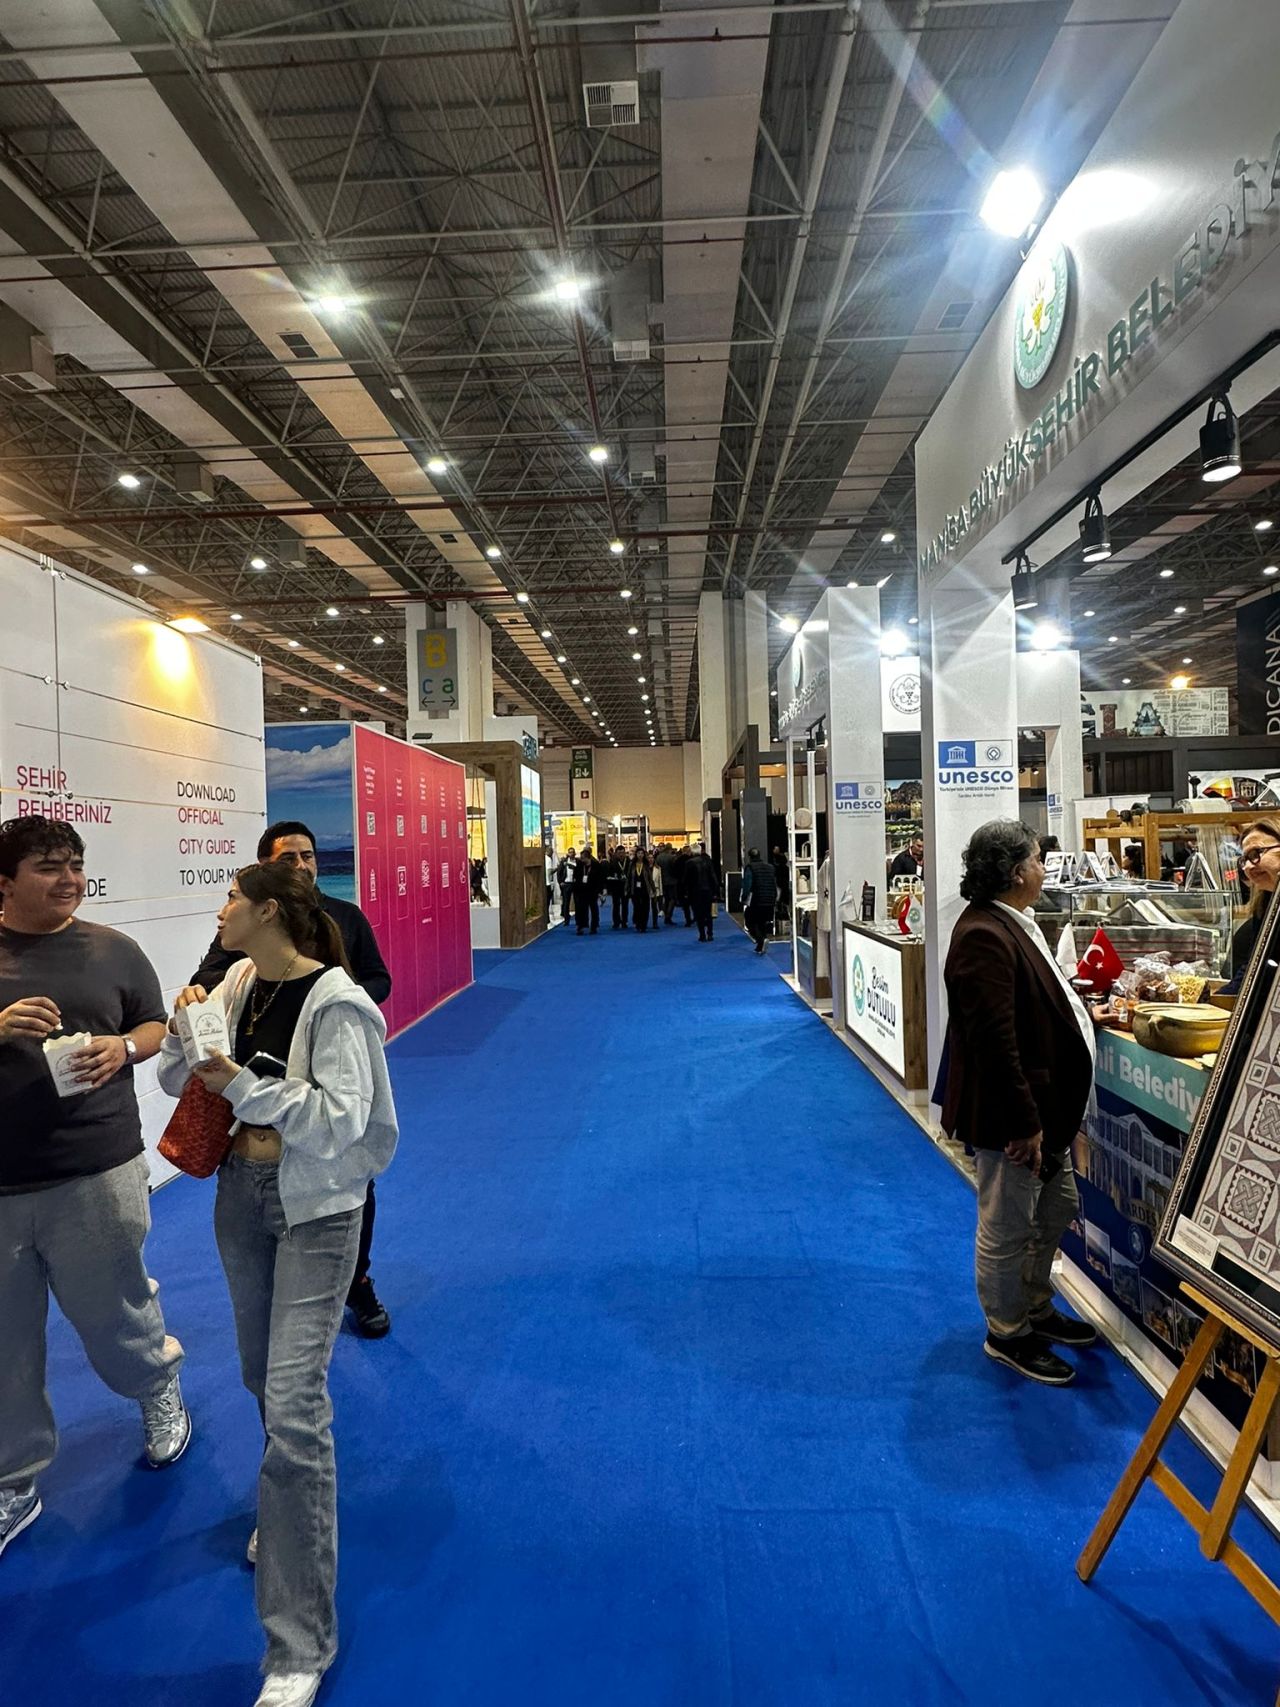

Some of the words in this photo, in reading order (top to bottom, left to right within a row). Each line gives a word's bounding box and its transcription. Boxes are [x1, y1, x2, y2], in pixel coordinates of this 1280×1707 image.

[424, 633, 448, 669] B
[442, 678, 454, 694] a
[16, 765, 67, 790] ŞEHİR
[939, 770, 1013, 784] unesco
[177, 781, 236, 803] DOWNLOAD
[18, 799, 112, 824] REHBERİNİZ
[836, 800, 882, 810] unesco
[178, 807, 224, 825] OFFICIAL
[179, 838, 204, 855] CITY
[206, 839, 236, 855] GUIDE
[180, 870, 195, 886] TO
[197, 868, 225, 885] YOUR
[83, 878, 107, 897] DE
